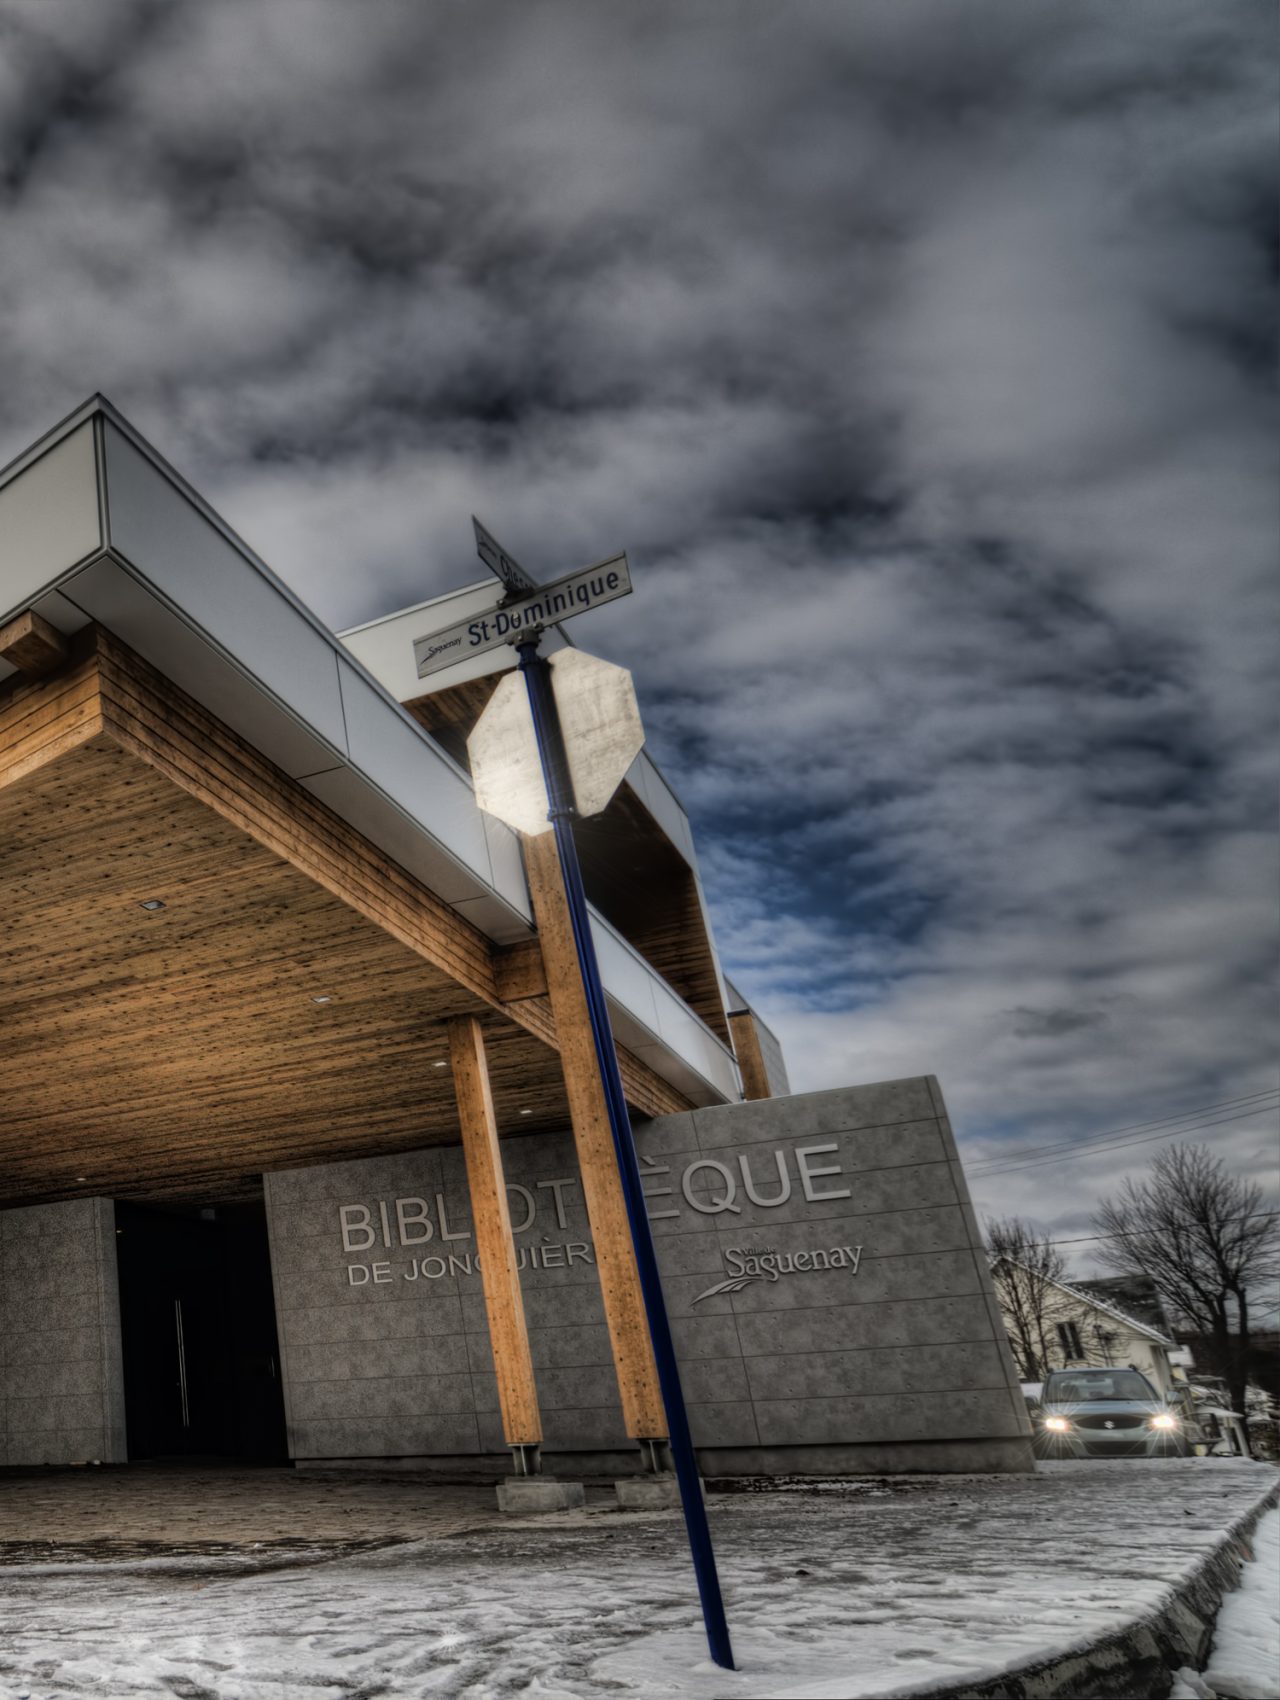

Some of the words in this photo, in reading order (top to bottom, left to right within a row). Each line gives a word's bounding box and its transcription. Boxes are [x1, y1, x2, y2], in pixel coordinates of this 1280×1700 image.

[468, 571, 619, 646] St-Dominique
[339, 1143, 852, 1252] BIBLOTÈQUE
[348, 1262, 393, 1286] DE
[404, 1236, 595, 1281] JONIÈR
[725, 1246, 863, 1281] Saguenay
